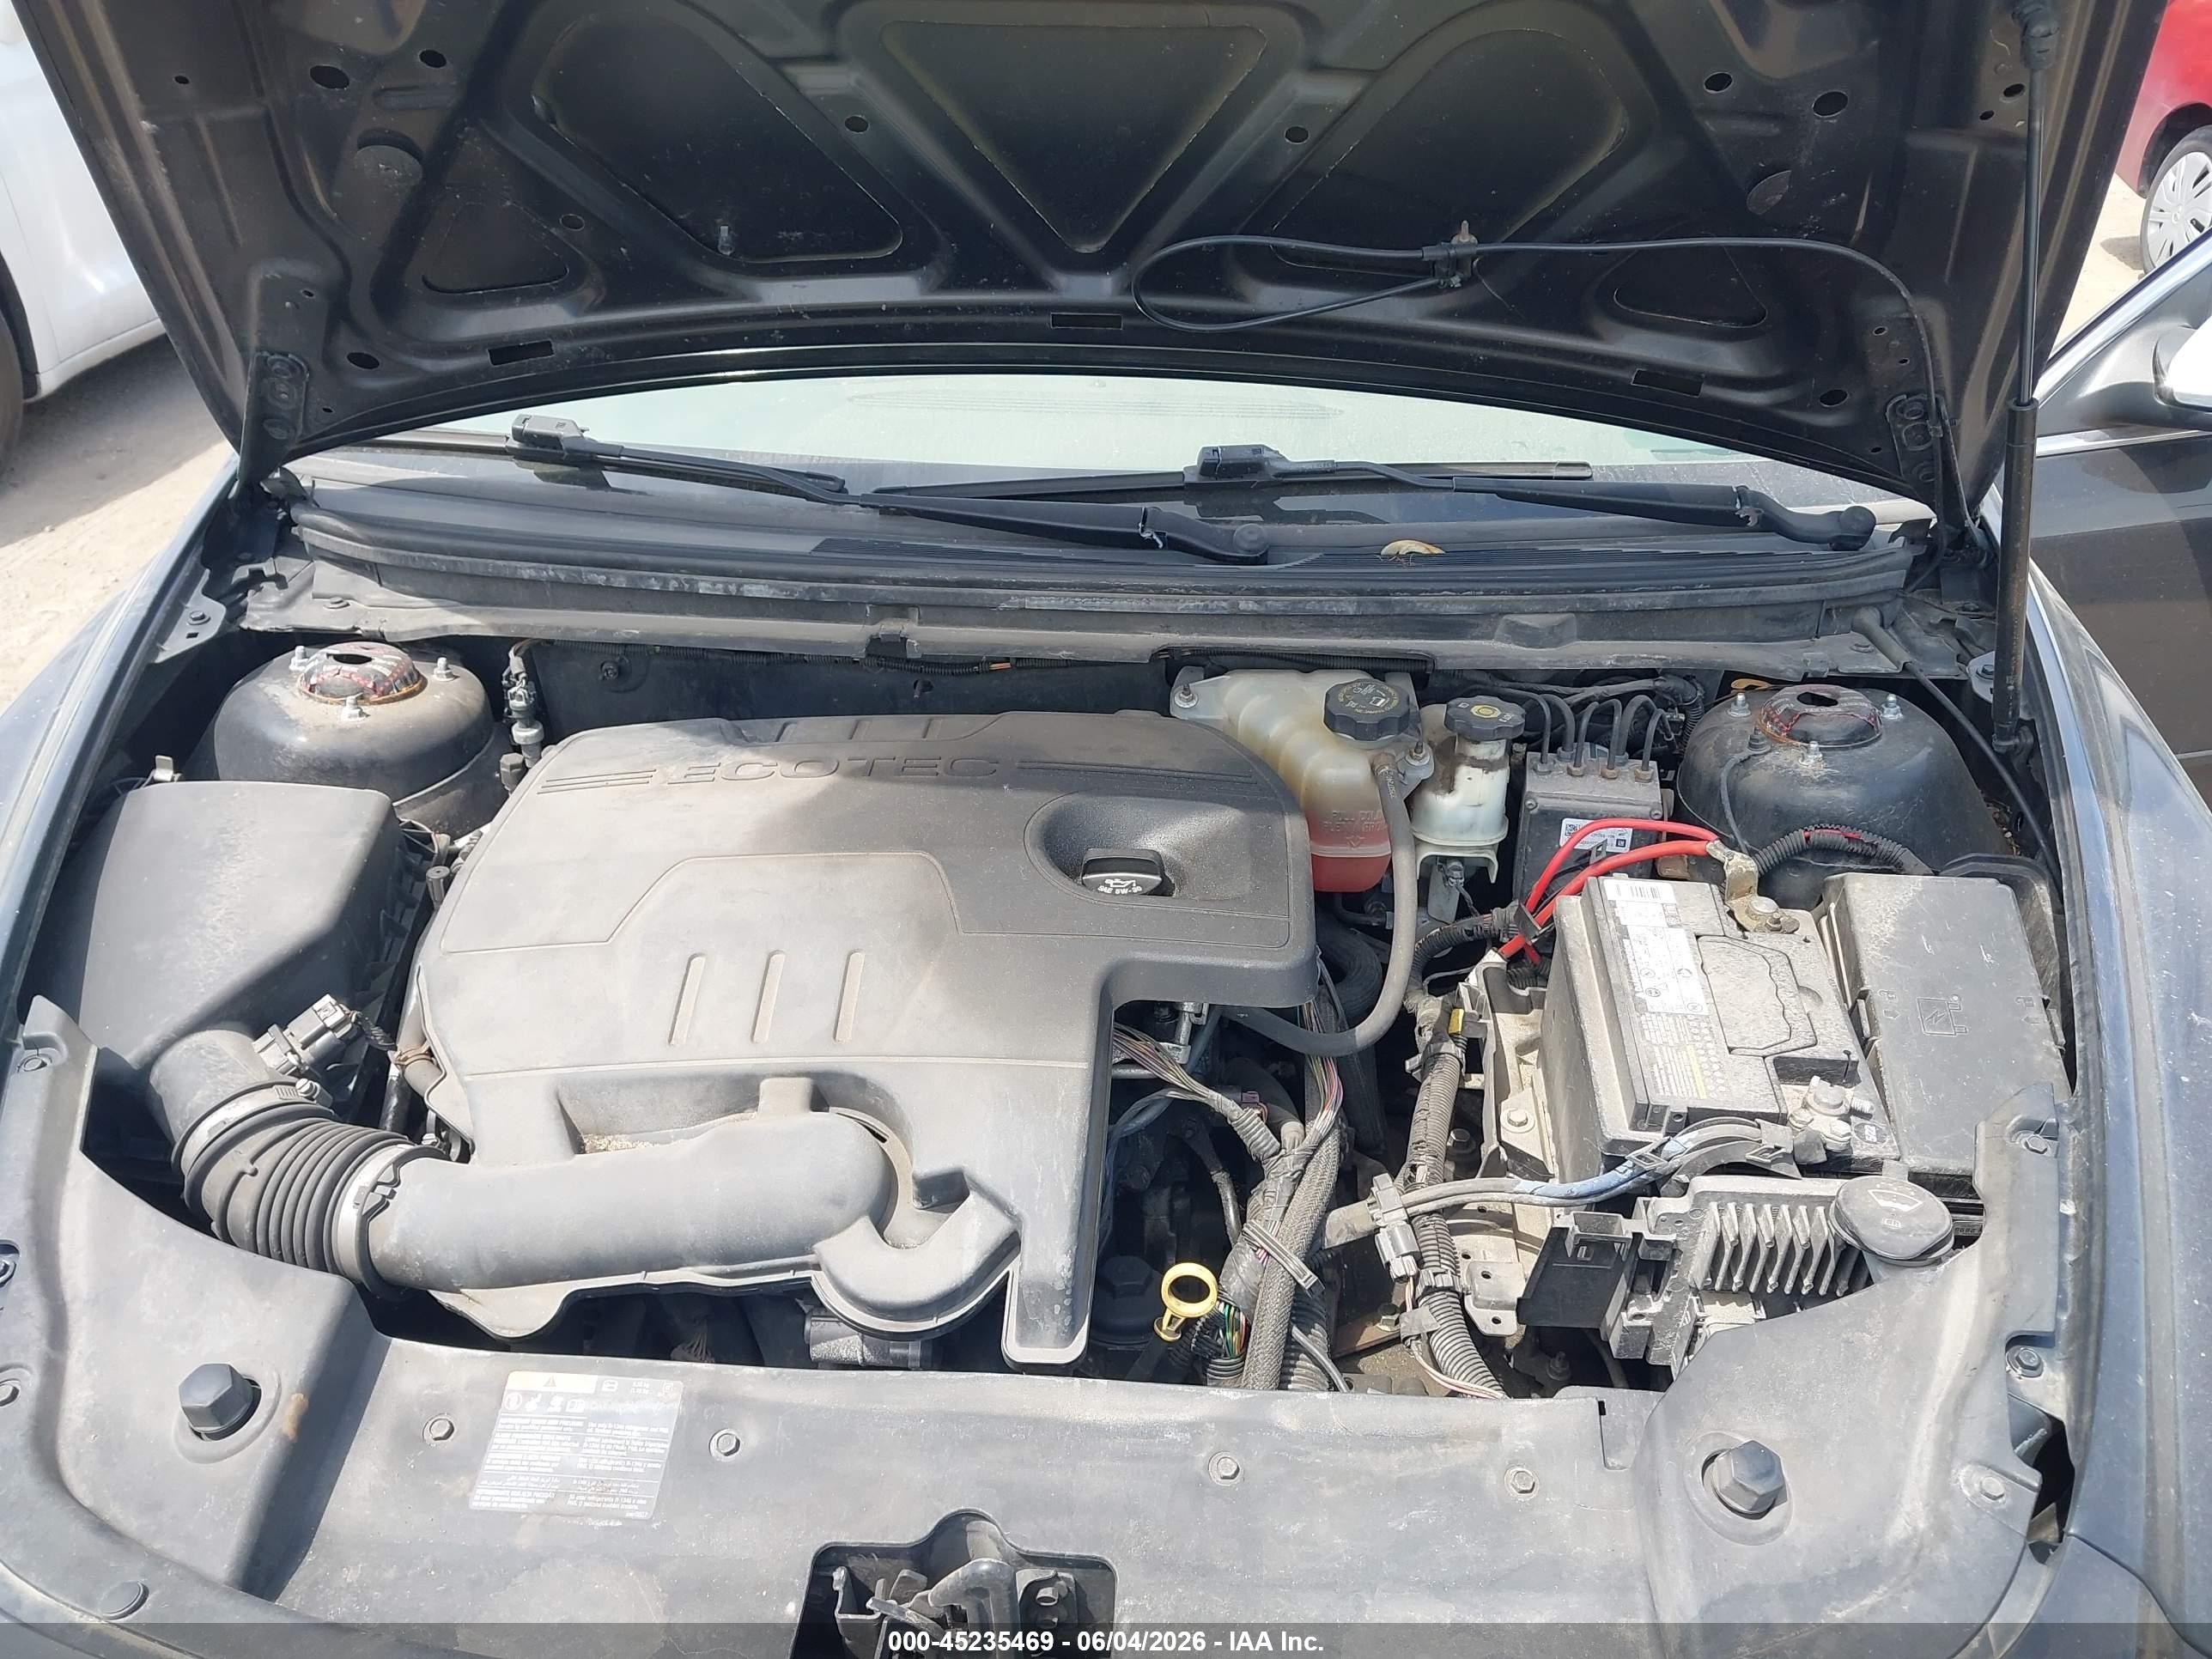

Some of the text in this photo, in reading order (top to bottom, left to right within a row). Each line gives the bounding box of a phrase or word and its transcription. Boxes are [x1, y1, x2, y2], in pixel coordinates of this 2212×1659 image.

[667, 757, 999, 785] ECOTEC
[1097, 885, 1142, 895] SAE 5W-30
